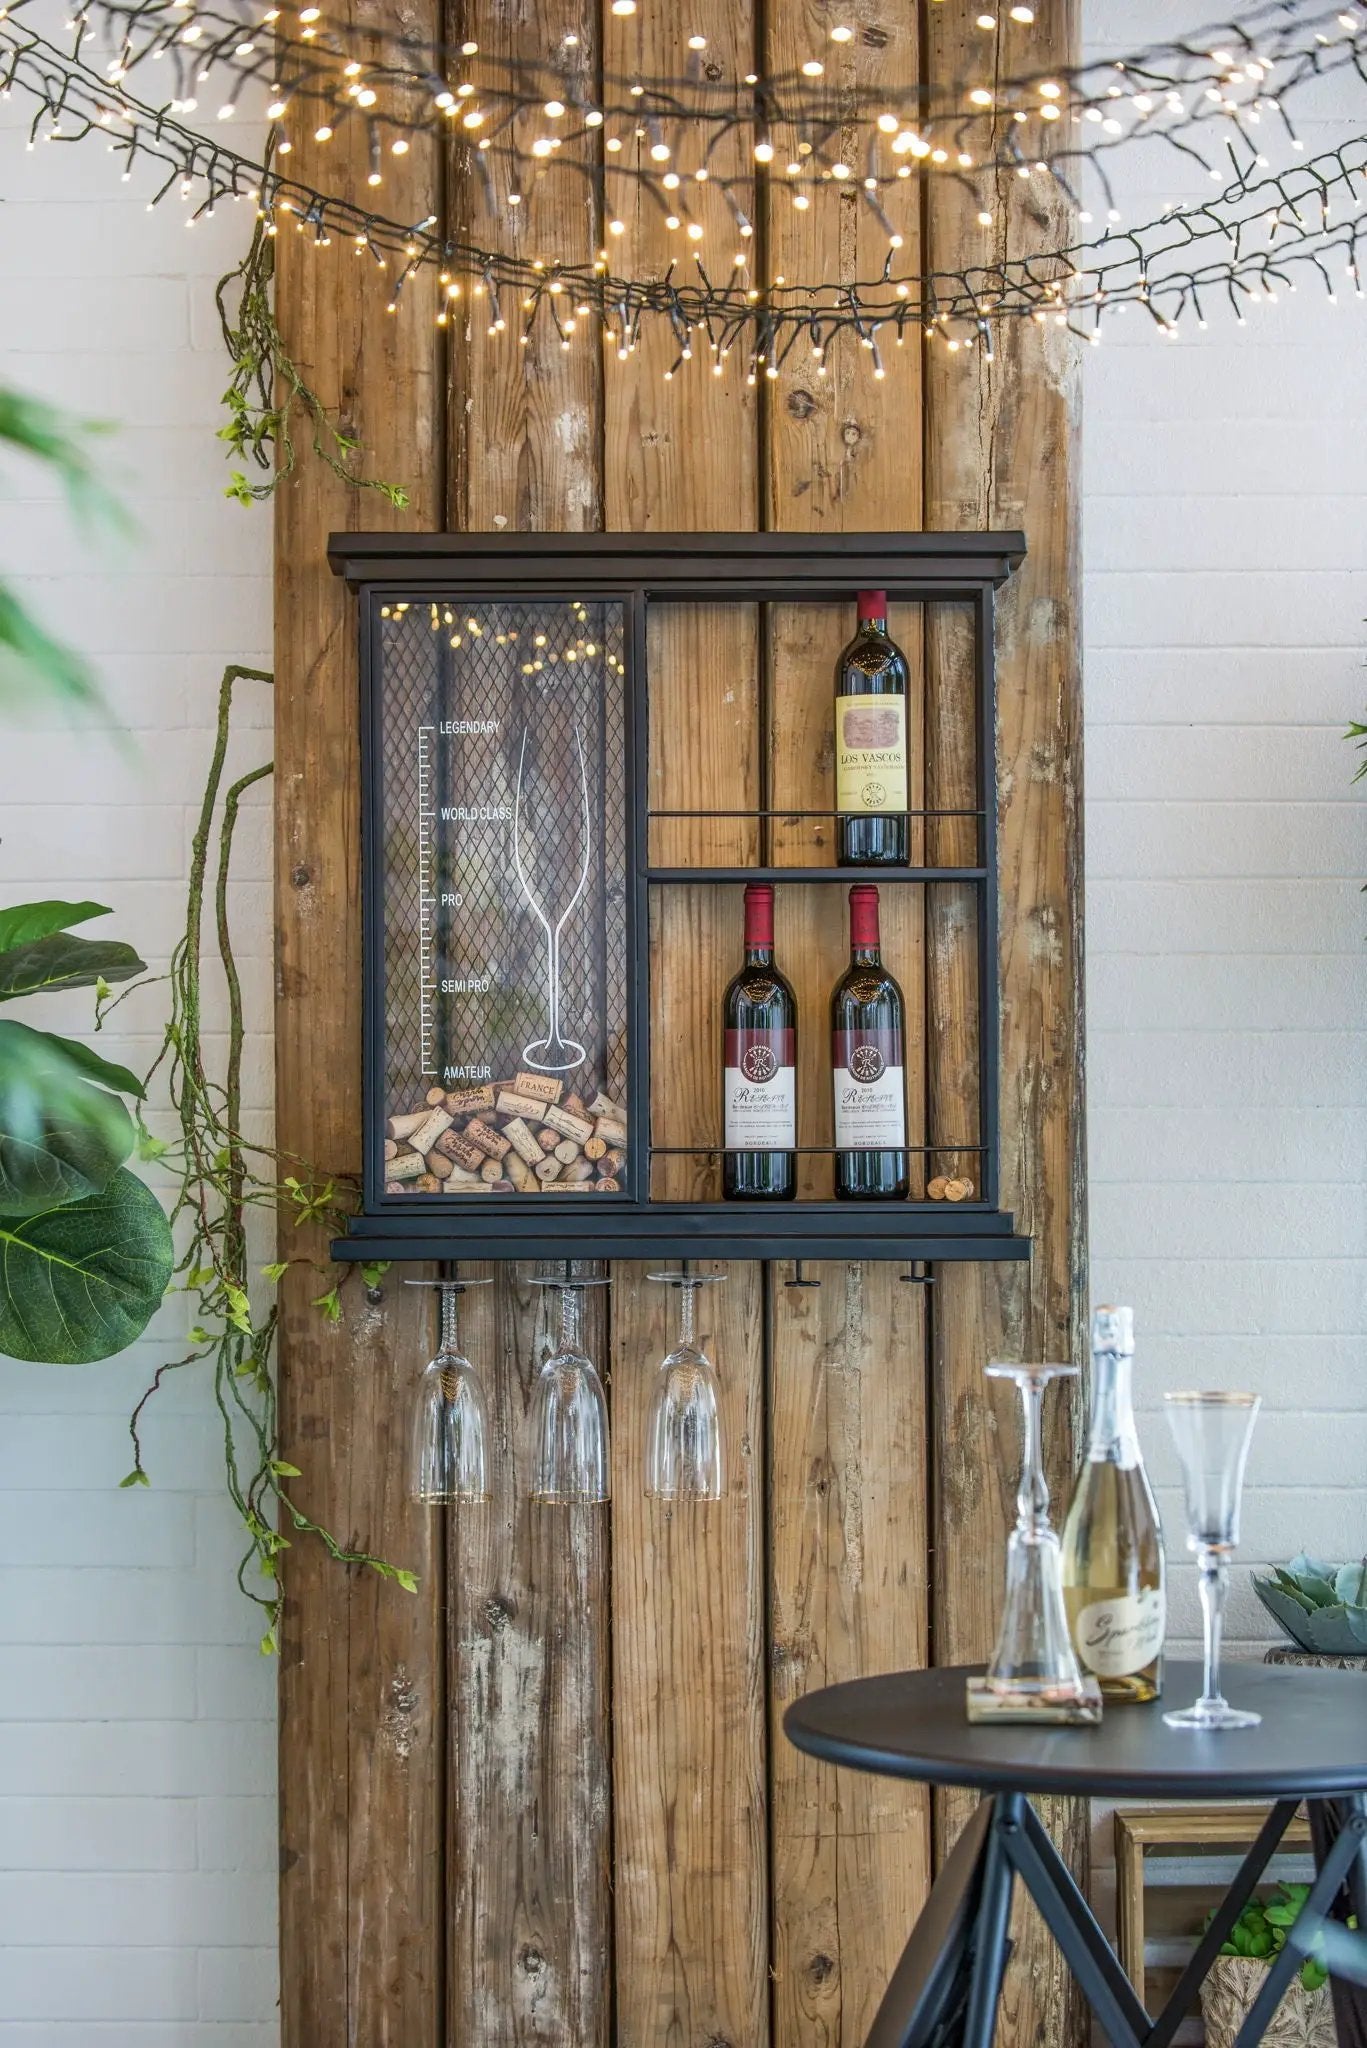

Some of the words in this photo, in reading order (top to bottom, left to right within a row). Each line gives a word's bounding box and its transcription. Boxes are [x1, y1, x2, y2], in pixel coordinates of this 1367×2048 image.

[440, 721, 500, 735] LEGENDARY
[841, 754, 858, 765] LOS
[862, 753, 901, 763] VASCOS
[441, 807, 478, 821] WORLD
[480, 807, 512, 820] CLASS
[441, 893, 463, 907] PRO
[441, 979, 465, 993] SEMI
[468, 979, 489, 992] PRO
[444, 1065, 491, 1079] AMATEUR
[520, 1080, 555, 1095] FRANCE
